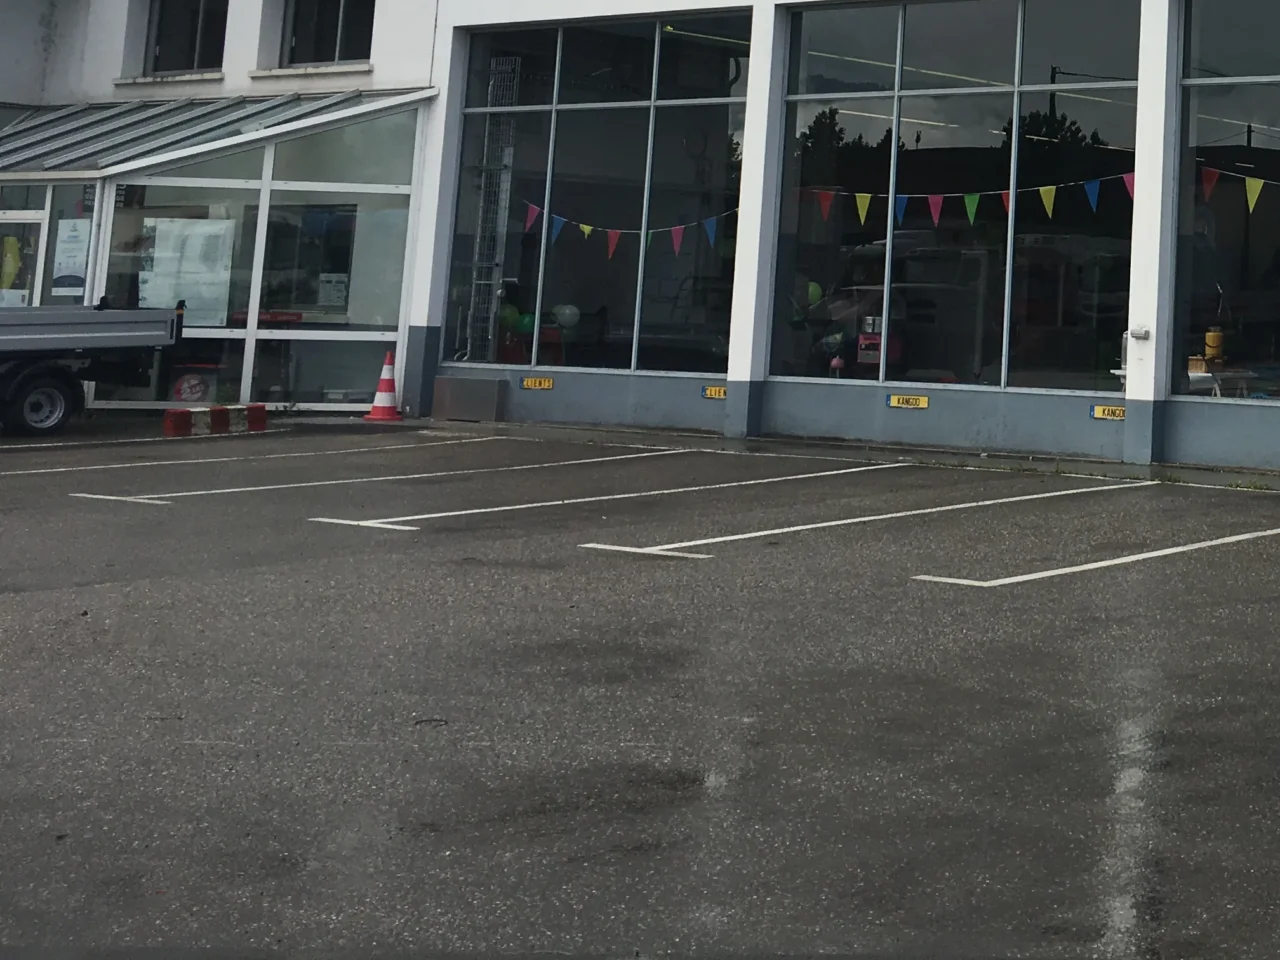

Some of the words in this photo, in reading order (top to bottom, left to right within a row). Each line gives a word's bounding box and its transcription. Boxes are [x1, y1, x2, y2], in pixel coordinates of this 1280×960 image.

[524, 379, 552, 388] CLIENTS
[705, 387, 727, 397] CLIEN
[897, 396, 921, 407] KANGOO
